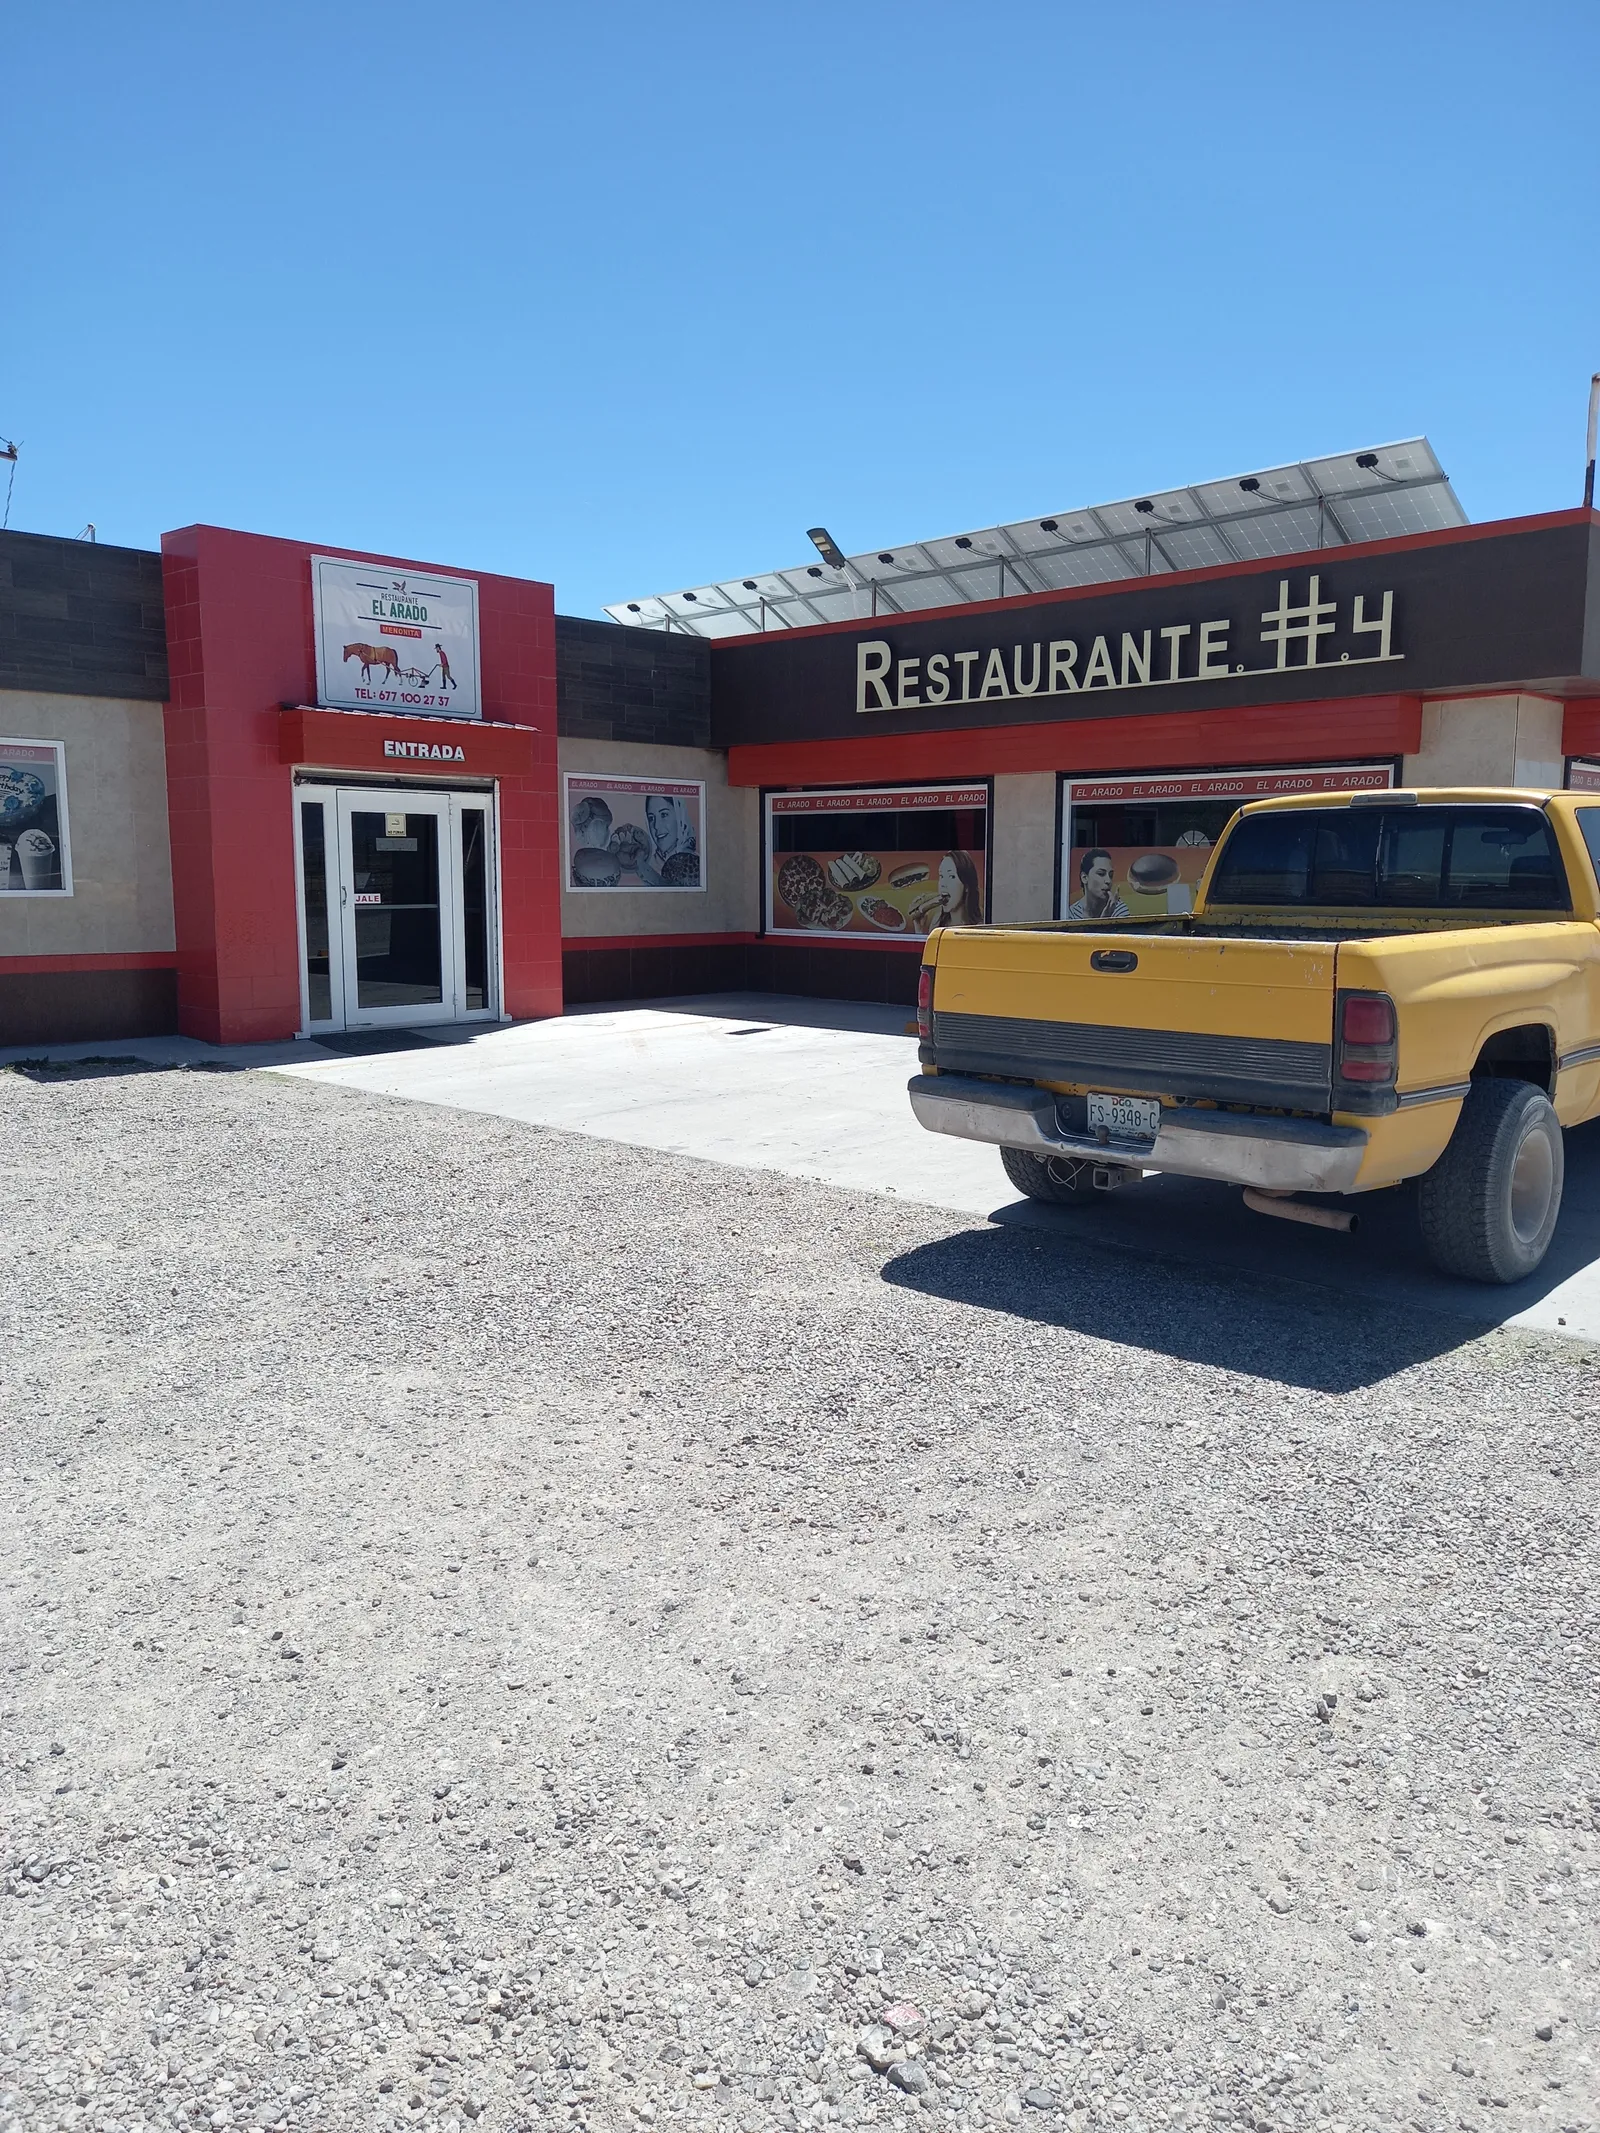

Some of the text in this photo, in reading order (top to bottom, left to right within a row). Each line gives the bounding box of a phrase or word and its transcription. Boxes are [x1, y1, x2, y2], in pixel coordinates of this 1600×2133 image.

[380, 593, 419, 605] RESTAURANTE
[372, 600, 427, 621] EL ARADO
[381, 626, 420, 637] MENONITA
[355, 688, 449, 706] TEL: 677 100 27 37
[2, 748, 35, 758] ARADO
[384, 740, 465, 761] ENTRADA
[1076, 776, 1383, 797] EL ARADO EL ARADO EL ARADO EL ARADO EL ARADO
[777, 793, 985, 809] EL ARADO EL ARADO EL ARADO EL ARADO EL ARADO
[356, 895, 380, 903] JALE
[1090, 1104, 1156, 1129] FS-9348-C
